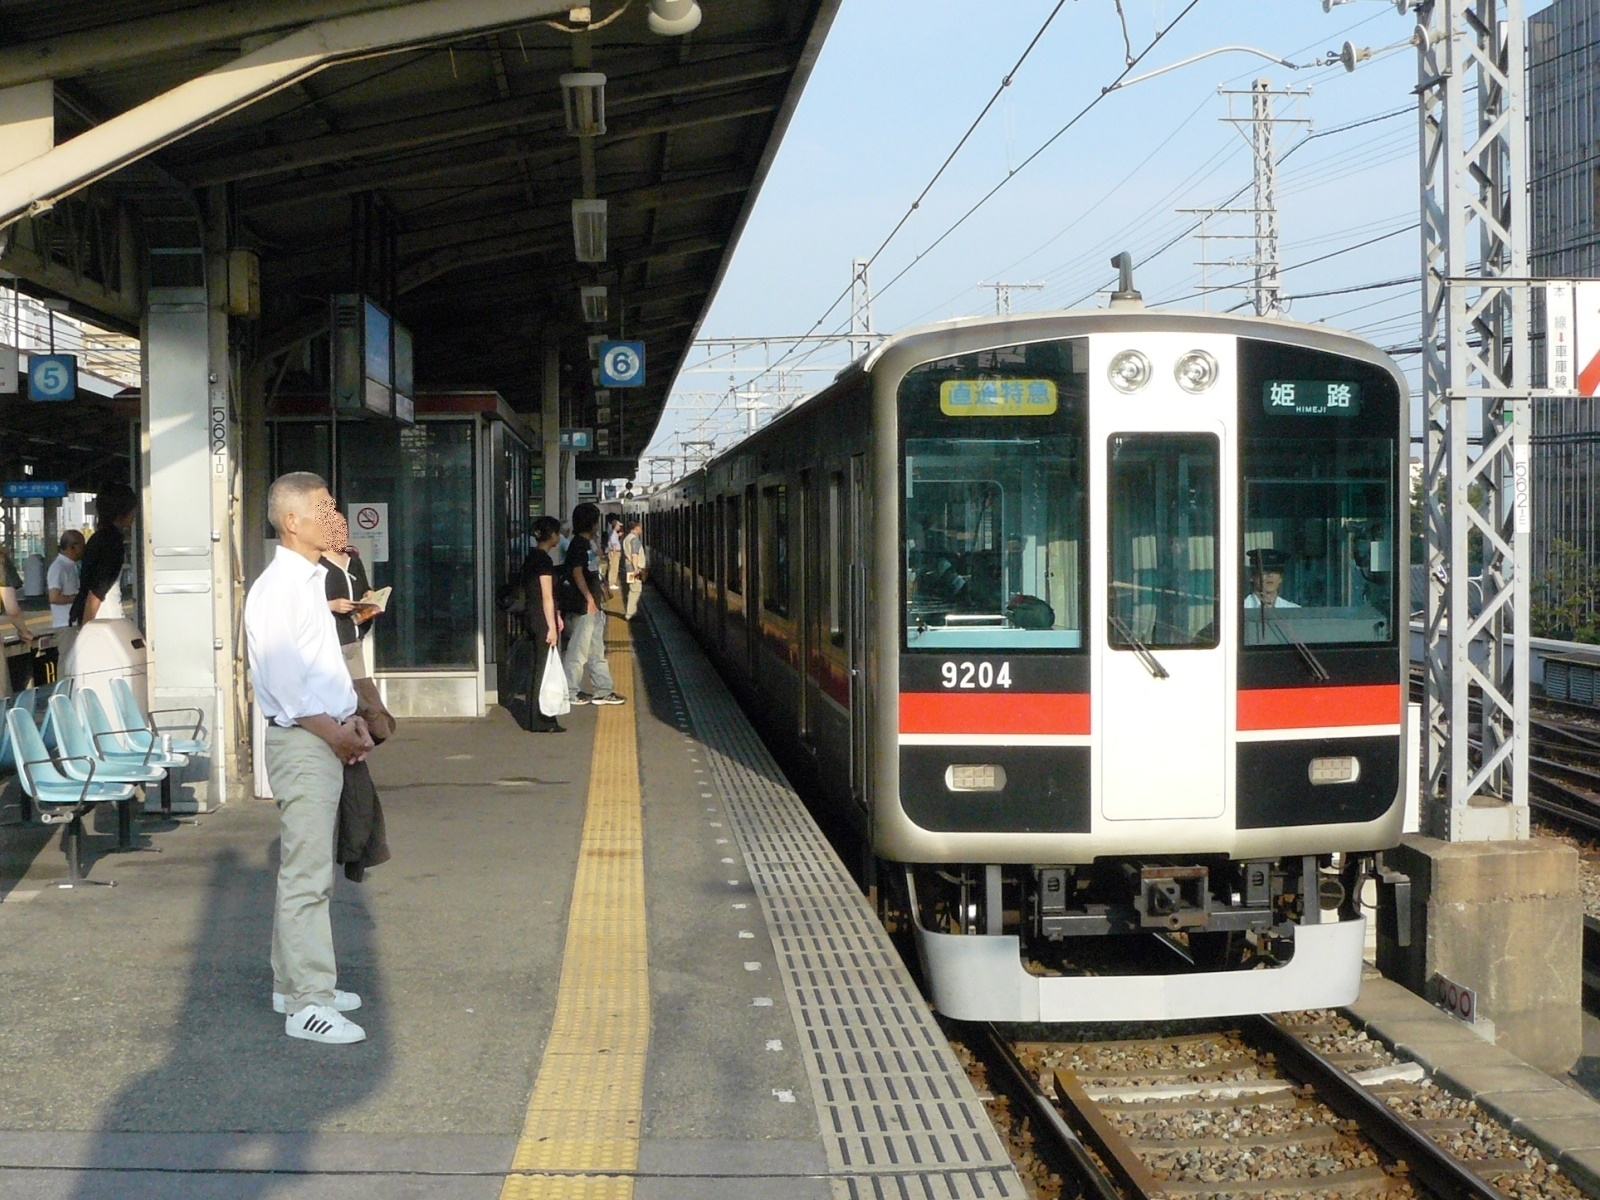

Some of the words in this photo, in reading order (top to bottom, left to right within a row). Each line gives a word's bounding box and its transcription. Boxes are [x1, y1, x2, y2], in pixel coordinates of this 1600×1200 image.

[613, 352, 631, 375] 6
[1554, 344, 1568, 389] 車庫線
[43, 367, 61, 390] 5
[1270, 382, 1352, 408] 姫路
[941, 661, 1012, 689] 9204
